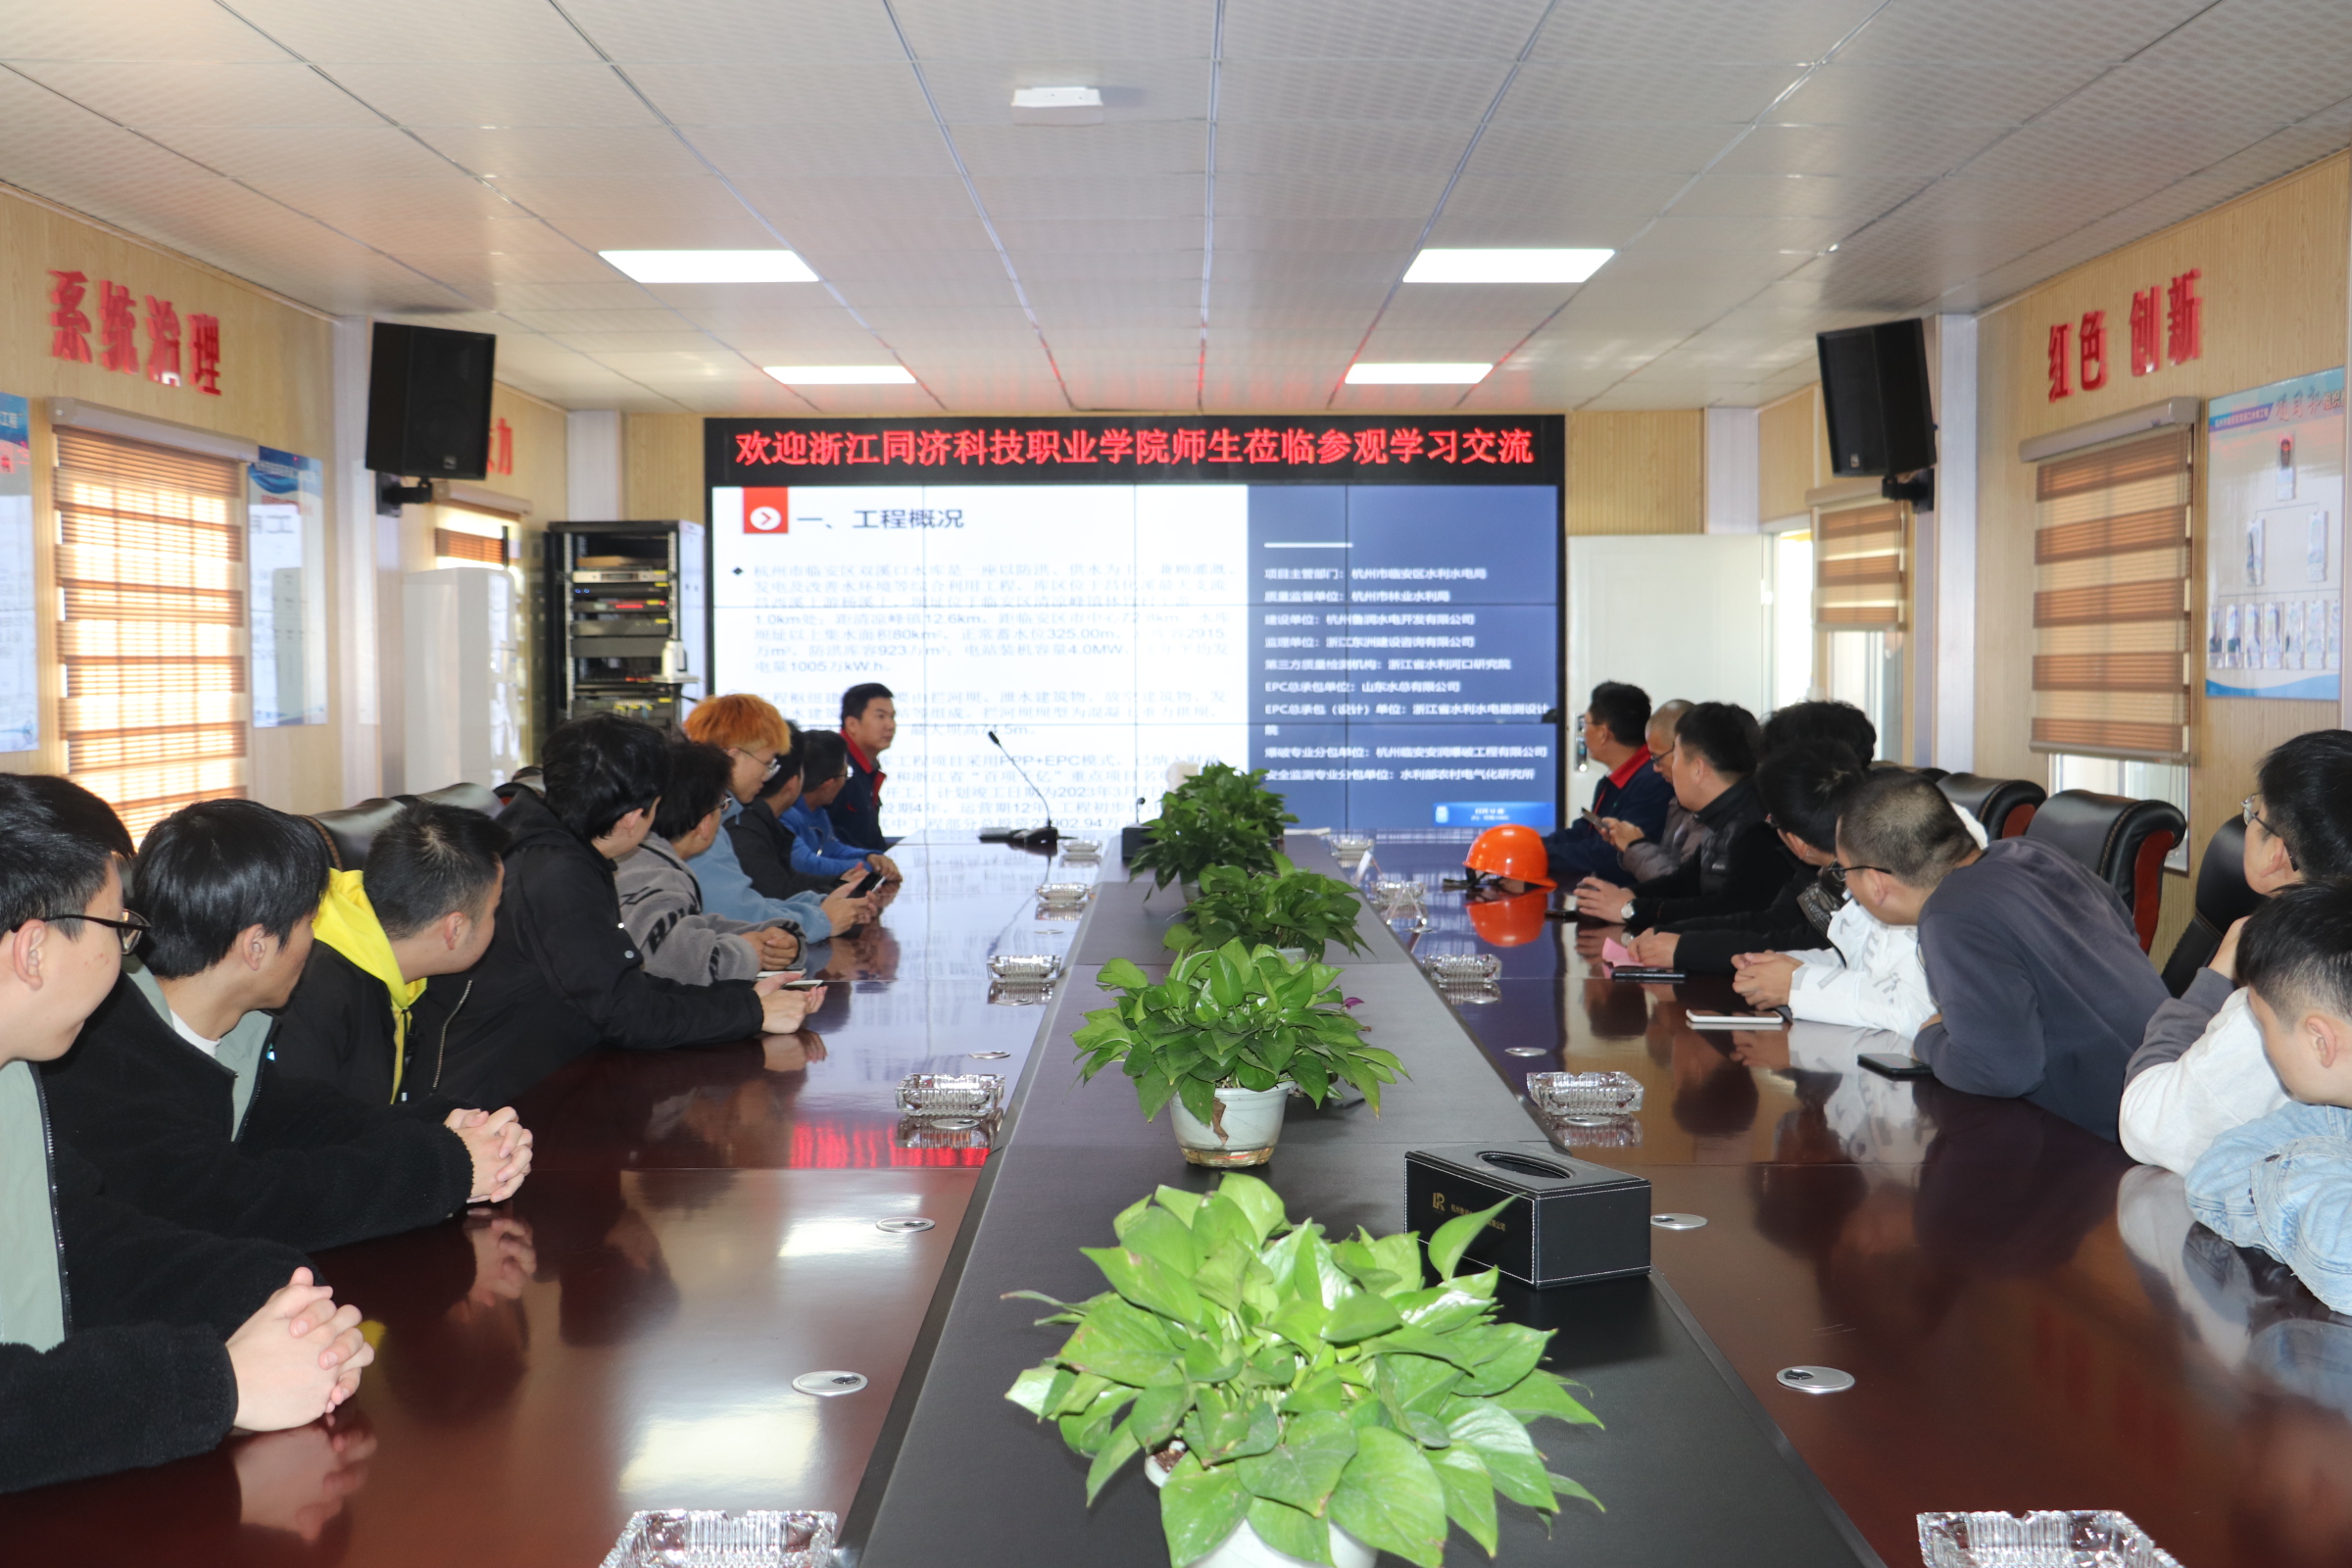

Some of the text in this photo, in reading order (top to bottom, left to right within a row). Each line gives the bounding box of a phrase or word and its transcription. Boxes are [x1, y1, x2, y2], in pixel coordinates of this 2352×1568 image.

[49, 270, 222, 396] 系统治理
[2047, 268, 2202, 404] 红色 创新
[735, 428, 1535, 466] 欢迎浙江同济科技职业学院师生莅临参观学习交流
[797, 509, 964, 529] 一、工程概况
